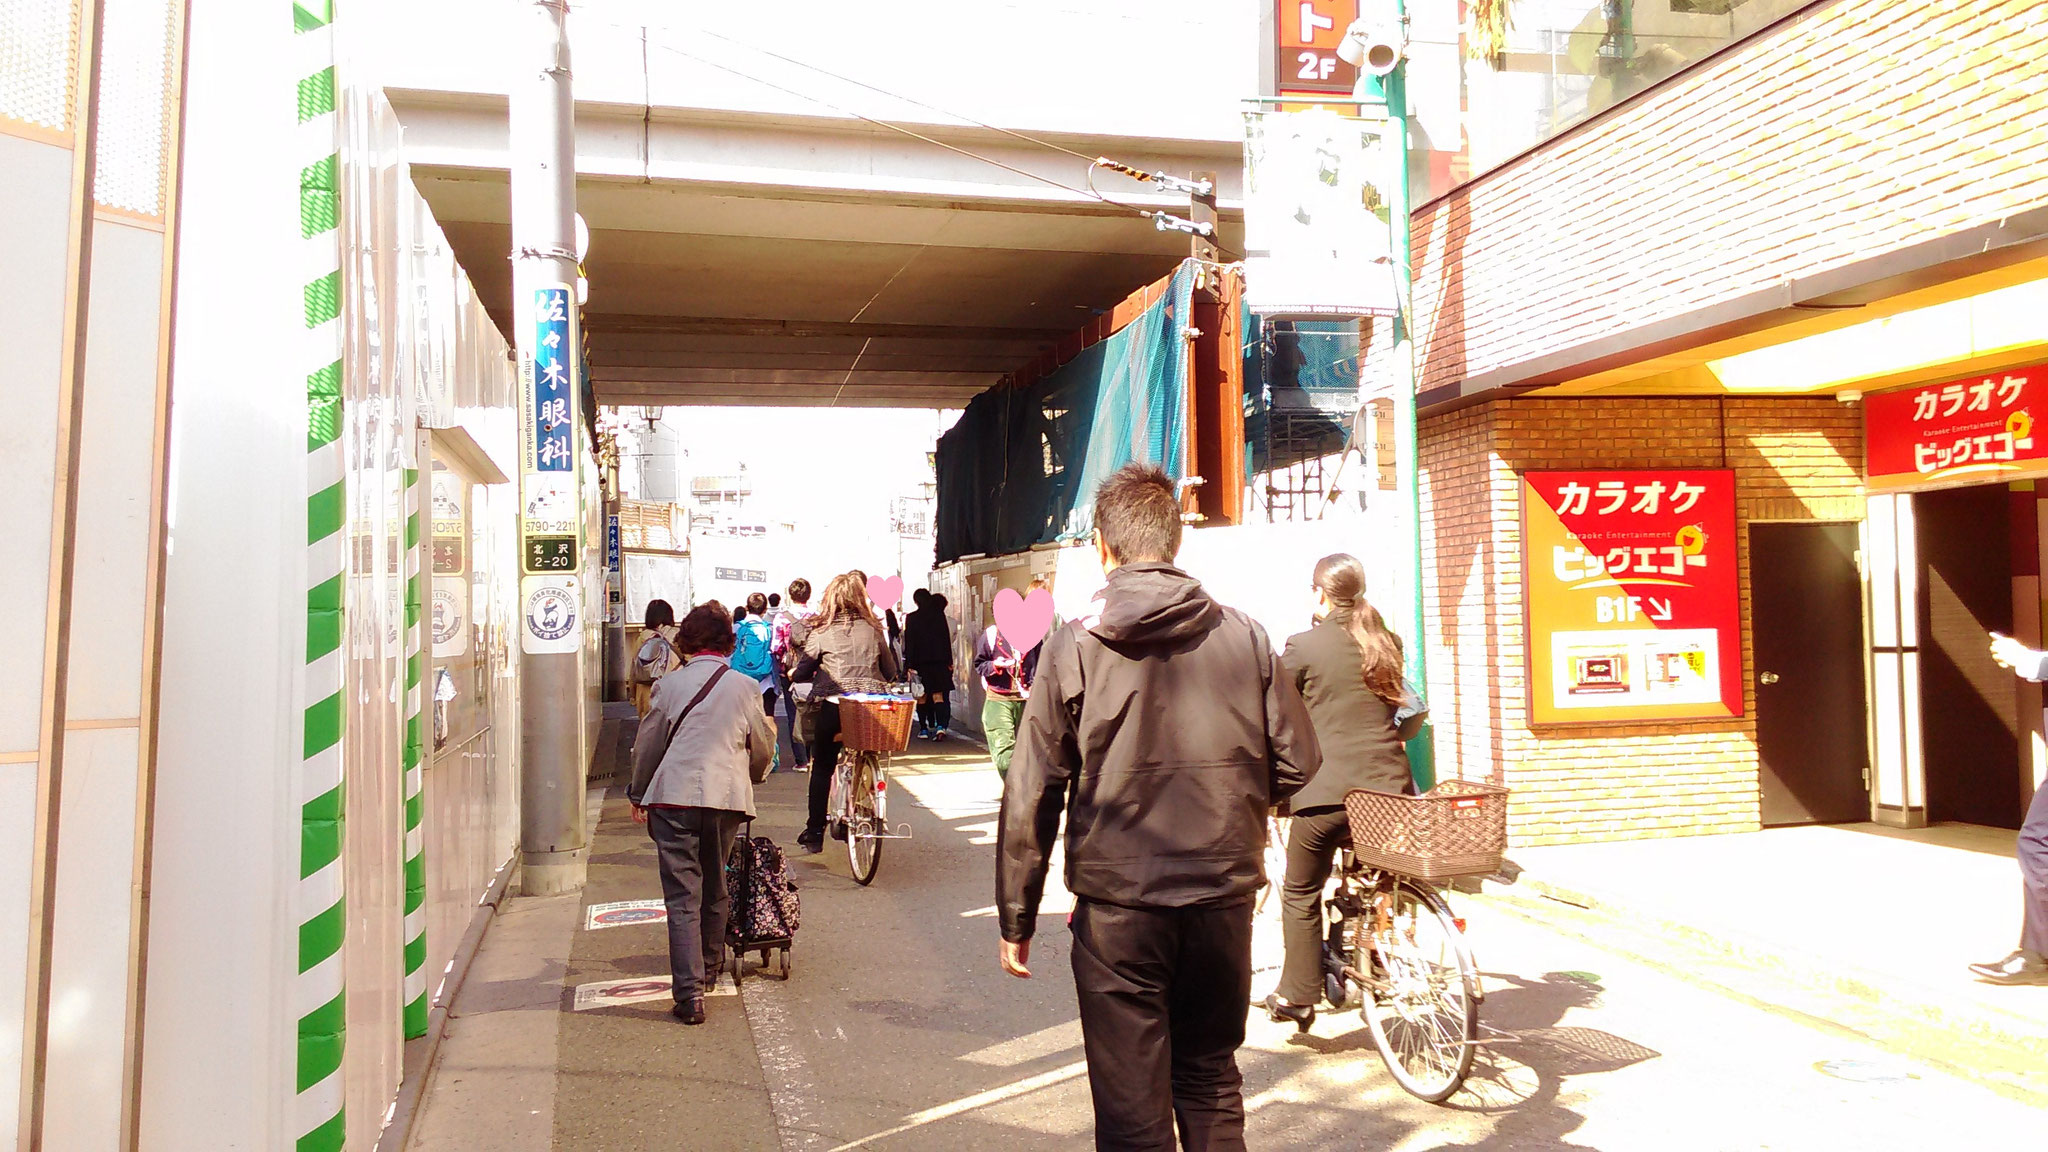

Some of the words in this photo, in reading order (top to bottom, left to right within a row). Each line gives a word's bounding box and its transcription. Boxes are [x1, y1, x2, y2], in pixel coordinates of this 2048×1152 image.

[1297, 52, 1336, 80] 2F
[535, 291, 571, 469] 佐々木眼科
[1913, 376, 2028, 421] カラオケ
[1914, 431, 2034, 473] ビッグエコー
[1557, 481, 1706, 515] カラオケ
[525, 521, 576, 532] 5790-2211
[1606, 531, 1672, 540] Entertainment
[533, 544, 569, 555] 北沢
[534, 557, 568, 567] 2-20
[1553, 545, 1707, 582] ビッグエコー
[1596, 596, 1643, 623] B1F
